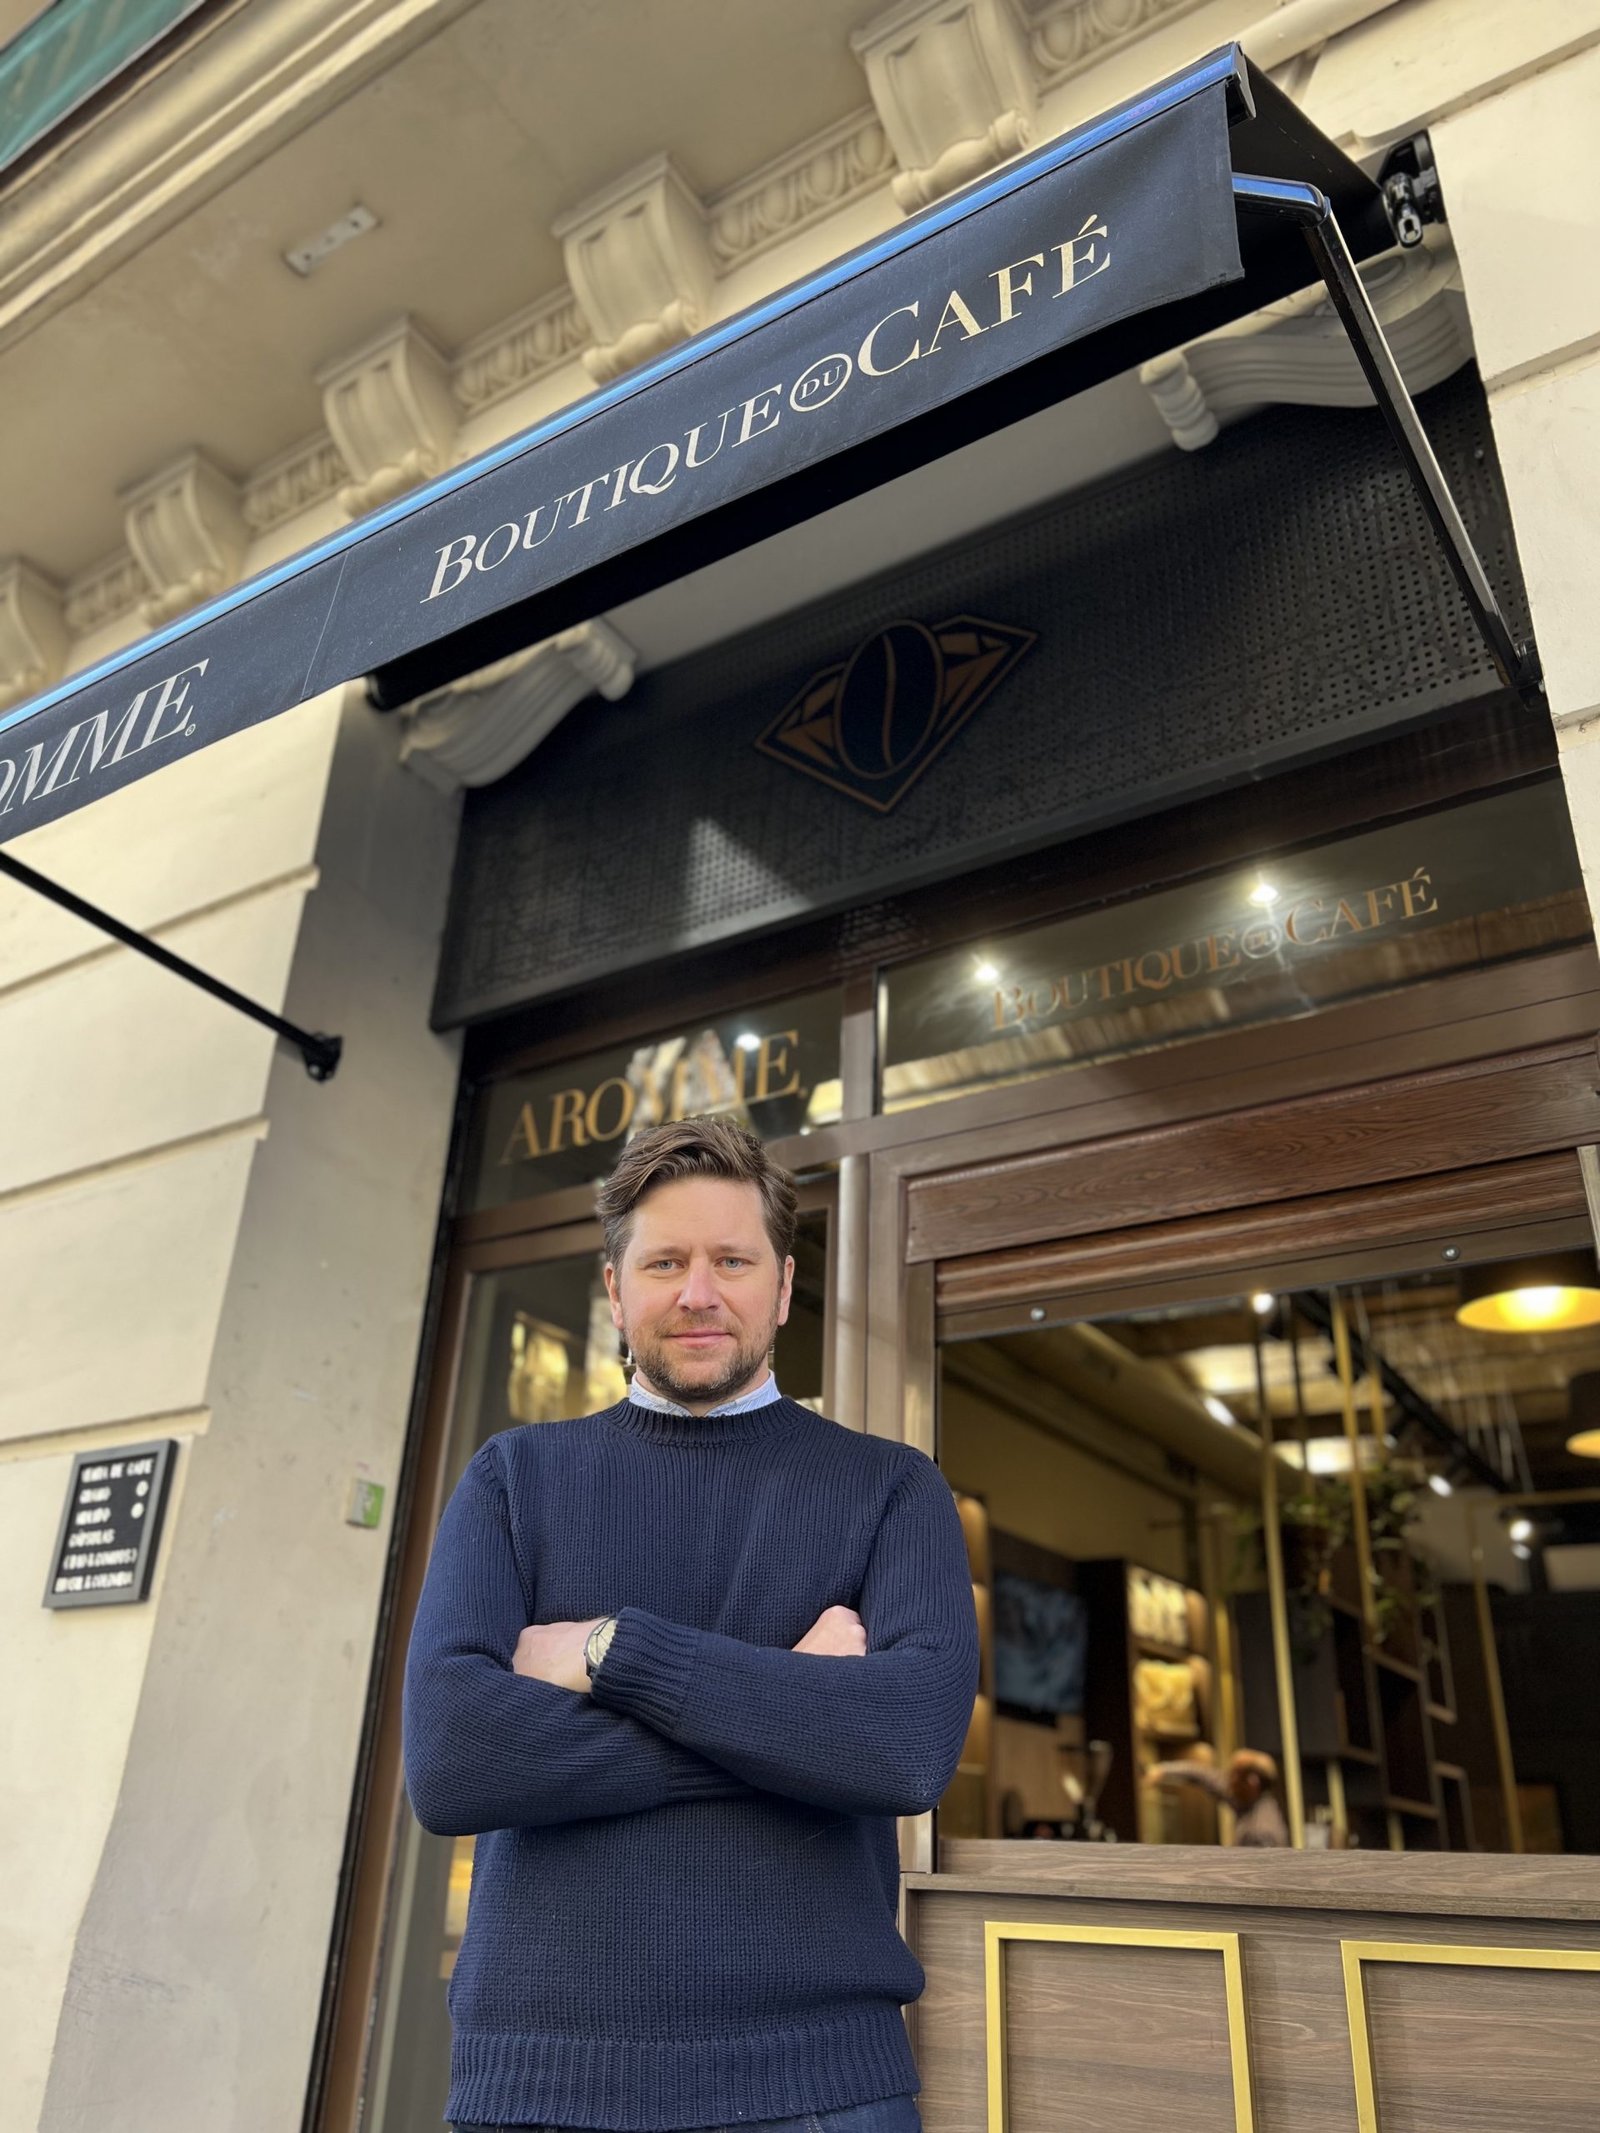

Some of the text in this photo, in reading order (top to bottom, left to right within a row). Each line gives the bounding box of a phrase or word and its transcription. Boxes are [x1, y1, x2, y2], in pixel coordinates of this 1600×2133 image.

[420, 214, 1111, 603] BOUTIQUE DU CAFÉ
[991, 929, 1241, 1032] BOUTIQUE
[1285, 866, 1438, 946] CAFÉ
